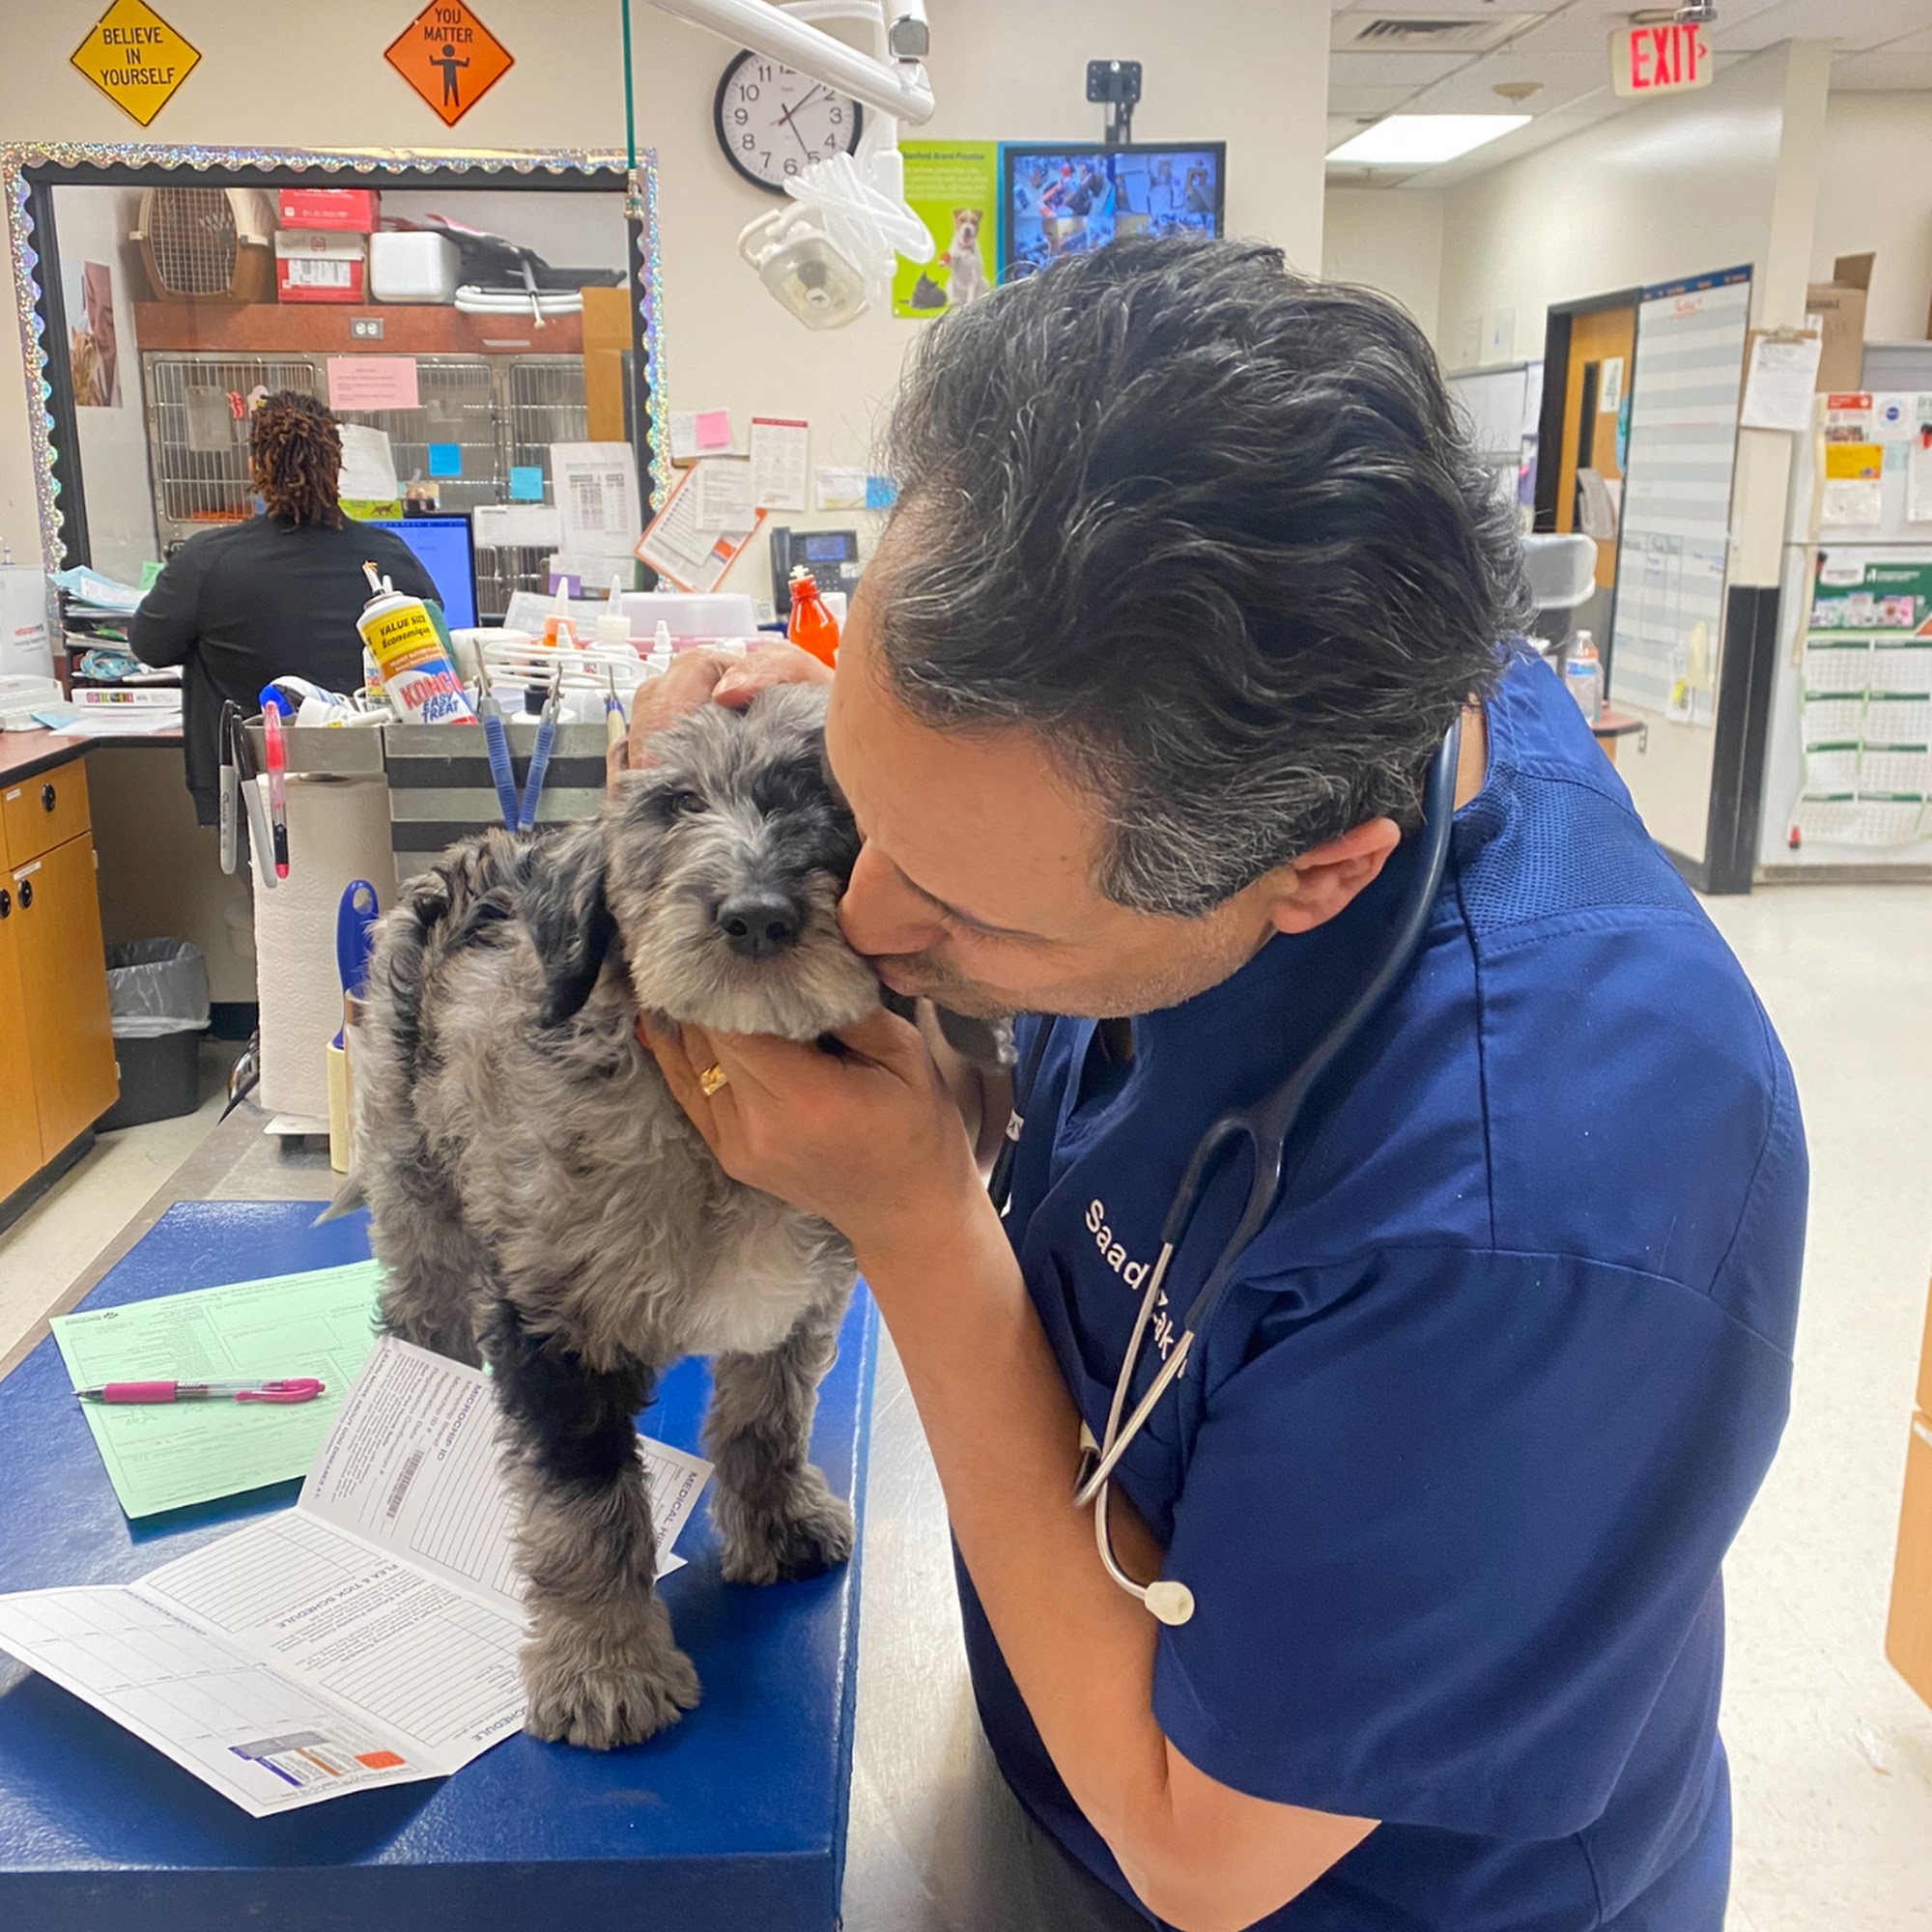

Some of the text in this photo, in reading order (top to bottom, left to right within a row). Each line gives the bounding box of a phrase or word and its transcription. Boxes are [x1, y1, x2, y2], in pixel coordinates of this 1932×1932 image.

[435, 8, 461, 24] YOU
[102, 27, 163, 44] BELIEVE
[424, 26, 473, 43] MATTER
[126, 48, 141, 65] IN
[1631, 24, 1699, 89] EXIT
[100, 68, 175, 86] YOURSELF
[758, 65, 772, 82] 11
[740, 84, 760, 101] 10
[734, 108, 749, 126] 9
[830, 107, 842, 125] 3
[742, 133, 755, 151] 8
[824, 132, 837, 149] 4
[760, 152, 772, 168] 7
[783, 158, 798, 176] 6
[380, 618, 410, 637] VALUE
[399, 671, 455, 711] KONG
[423, 692, 453, 711] EASY
[421, 699, 459, 724] TREAT
[1085, 1198, 1151, 1291] Saad
[437, 1384, 481, 1461] MICROCHIP ID
[664, 1470, 697, 1523] MEDICAL
[371, 1563, 399, 1580] FLEA
[338, 1582, 362, 1598] TICK
[275, 1596, 336, 1629] SCHEDULE
